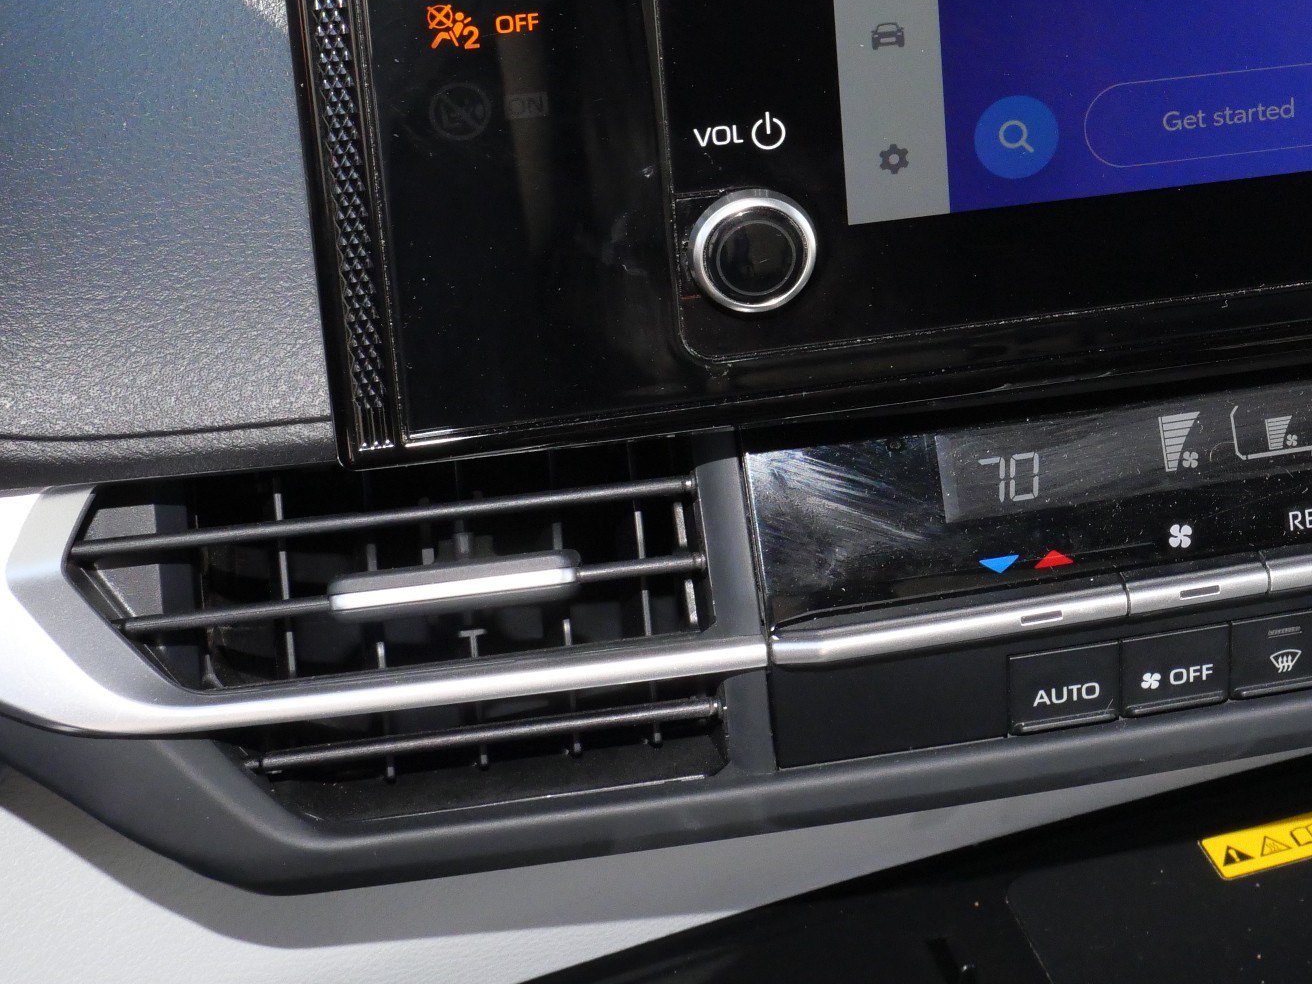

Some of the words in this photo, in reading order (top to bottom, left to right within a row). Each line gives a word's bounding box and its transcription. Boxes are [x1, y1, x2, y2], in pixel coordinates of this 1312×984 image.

[495, 13, 539, 34] OFF
[1162, 110, 1207, 132] Get
[1213, 96, 1295, 127] started
[693, 125, 744, 148] VOL
[978, 451, 1039, 503] 70
[1169, 663, 1214, 686] OFF
[1033, 682, 1101, 708] AUTO
